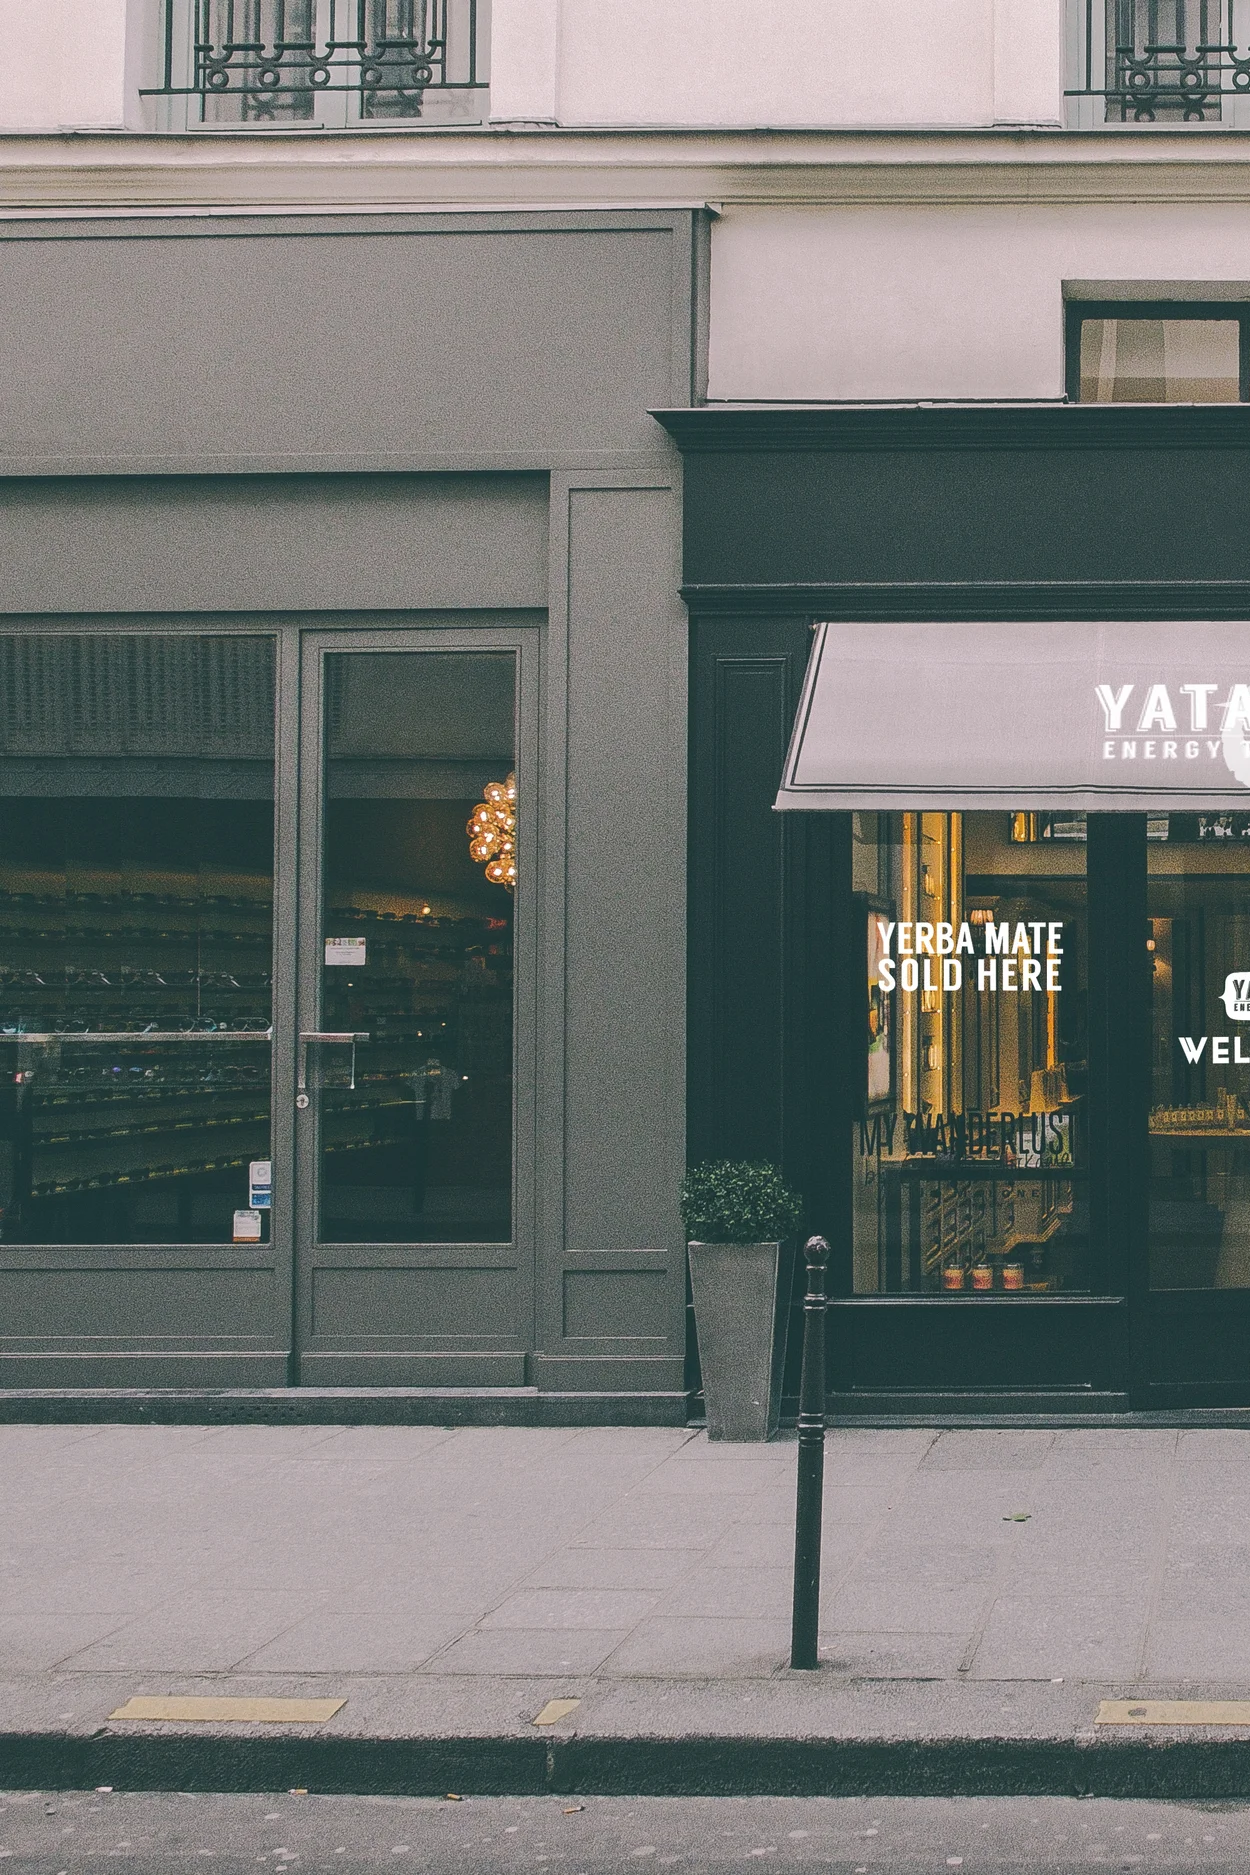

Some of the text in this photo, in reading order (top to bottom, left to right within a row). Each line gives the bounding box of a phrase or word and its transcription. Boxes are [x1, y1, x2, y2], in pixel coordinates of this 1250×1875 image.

[1103, 740, 1221, 759] ENERGY
[877, 922, 1063, 954] YERBA MATE
[878, 958, 1062, 991] SOLD HERE
[860, 1113, 897, 1155] MY
